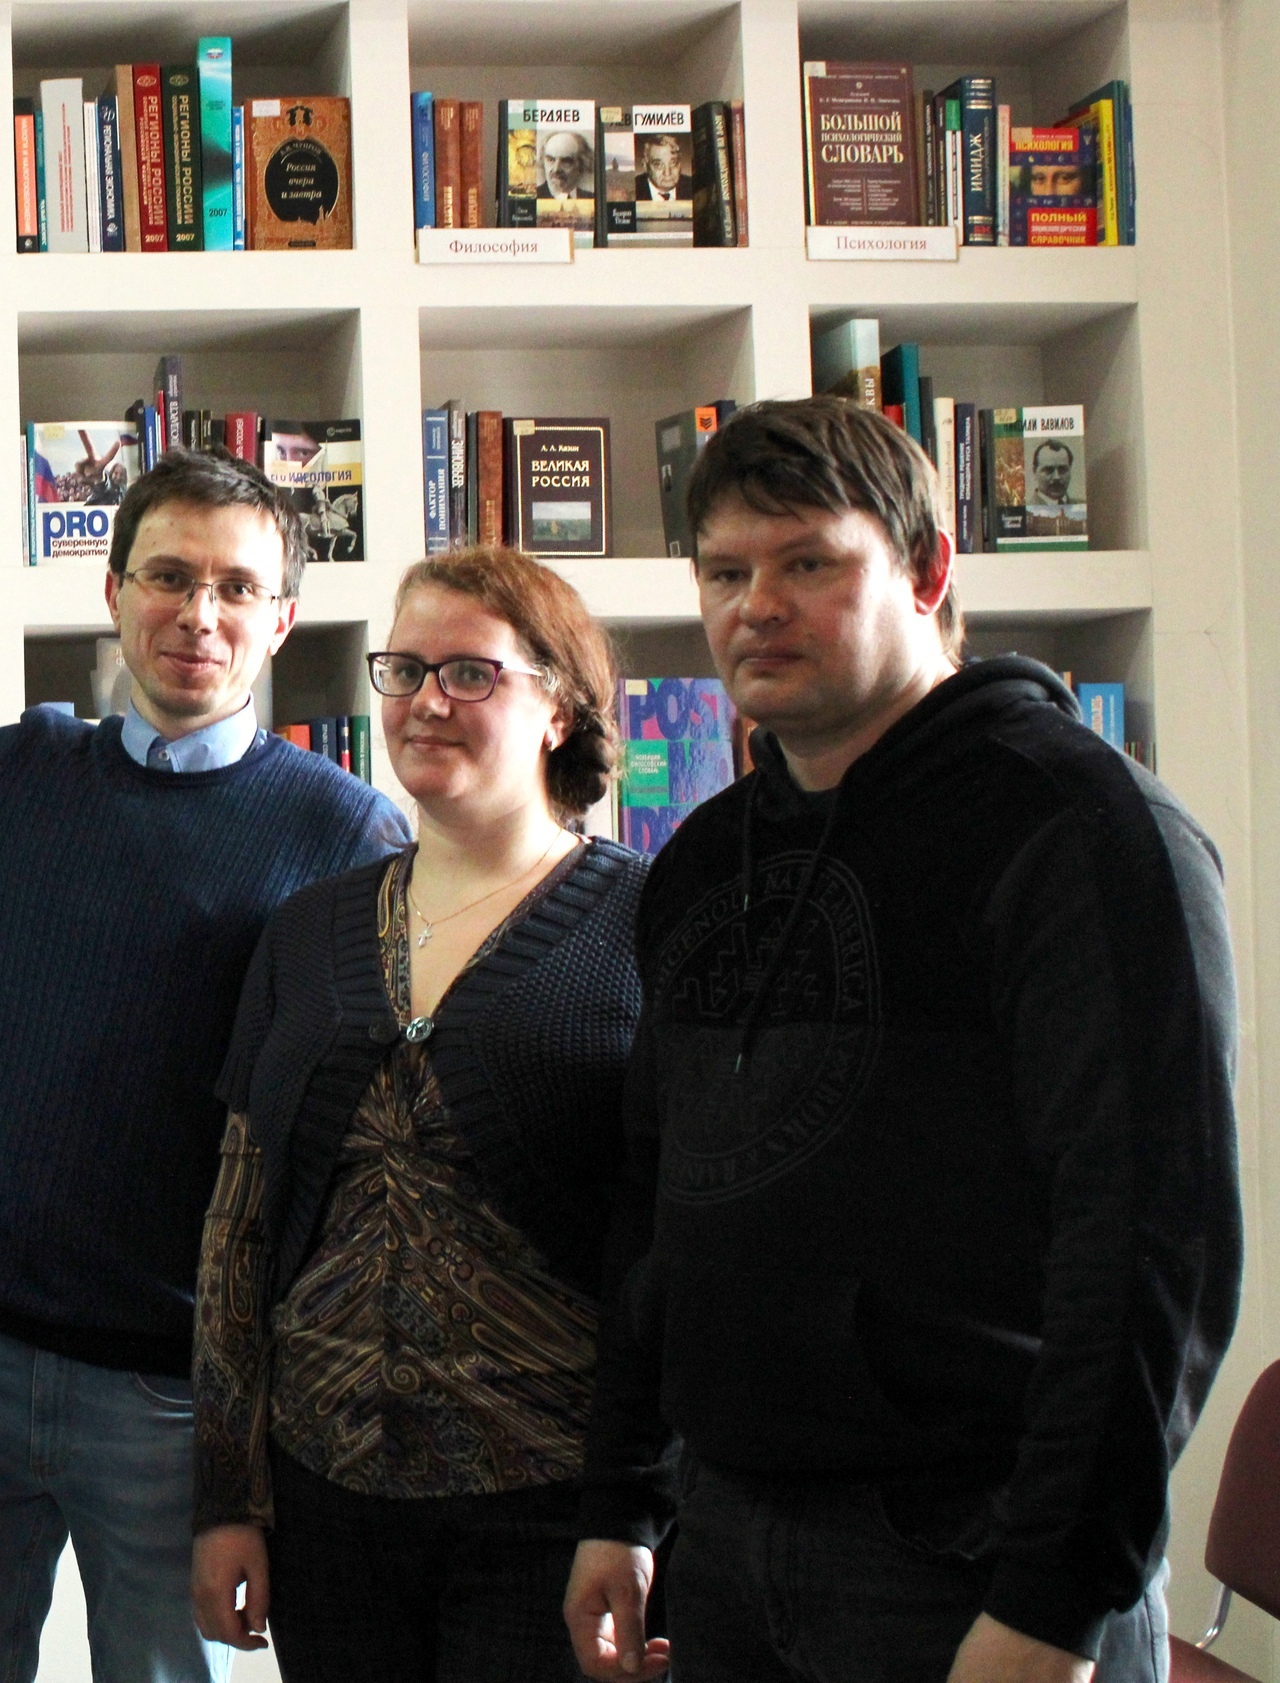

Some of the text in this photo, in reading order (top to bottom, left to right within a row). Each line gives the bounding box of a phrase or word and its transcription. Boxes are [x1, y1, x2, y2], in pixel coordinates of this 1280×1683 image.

[523, 109, 580, 122] БЕРДЯЕВ
[634, 110, 685, 127] ГУМИЛЁВ
[820, 111, 902, 132] БОЛЬШОЙ
[20, 118, 29, 149] НАЛОГИ
[821, 133, 903, 142] ПСИХОЛОГИЧЕСКИЙ
[148, 95, 164, 226] РЕГИОНЫ РОССИИ
[179, 95, 194, 225] РЕГИОНЫ РОССИИ
[821, 144, 904, 164] СЛОВАРЬ
[286, 163, 317, 172] Россия
[969, 132, 984, 192] ИМИДЖ
[103, 125, 115, 220] РЕГИОНАЛЬНАЯ ЭКОНОМИКА
[288, 177, 314, 188] вчера
[281, 190, 322, 200] и завтра
[208, 208, 228, 217] 2007
[1031, 211, 1087, 222] ПОЛНЫЙ
[145, 234, 164, 243] 2007
[176, 233, 195, 242] 2007
[836, 236, 927, 250] Психология
[1031, 235, 1086, 244] СПРАВОЧНИК
[449, 239, 538, 256] Философия
[865, 377, 876, 405] КВЫ
[1040, 417, 1074, 431] ВАВИЛОВ
[531, 460, 590, 471] ВЕЛИКАЯ
[288, 470, 352, 483] ИДЕОЛОГИЯ
[531, 475, 590, 487] РОССИЯ
[428, 480, 437, 519] ФАКТОР
[437, 468, 447, 531] ПОНИМАНИЯ
[51, 538, 108, 549] суверенную
[51, 548, 108, 560] демократию
